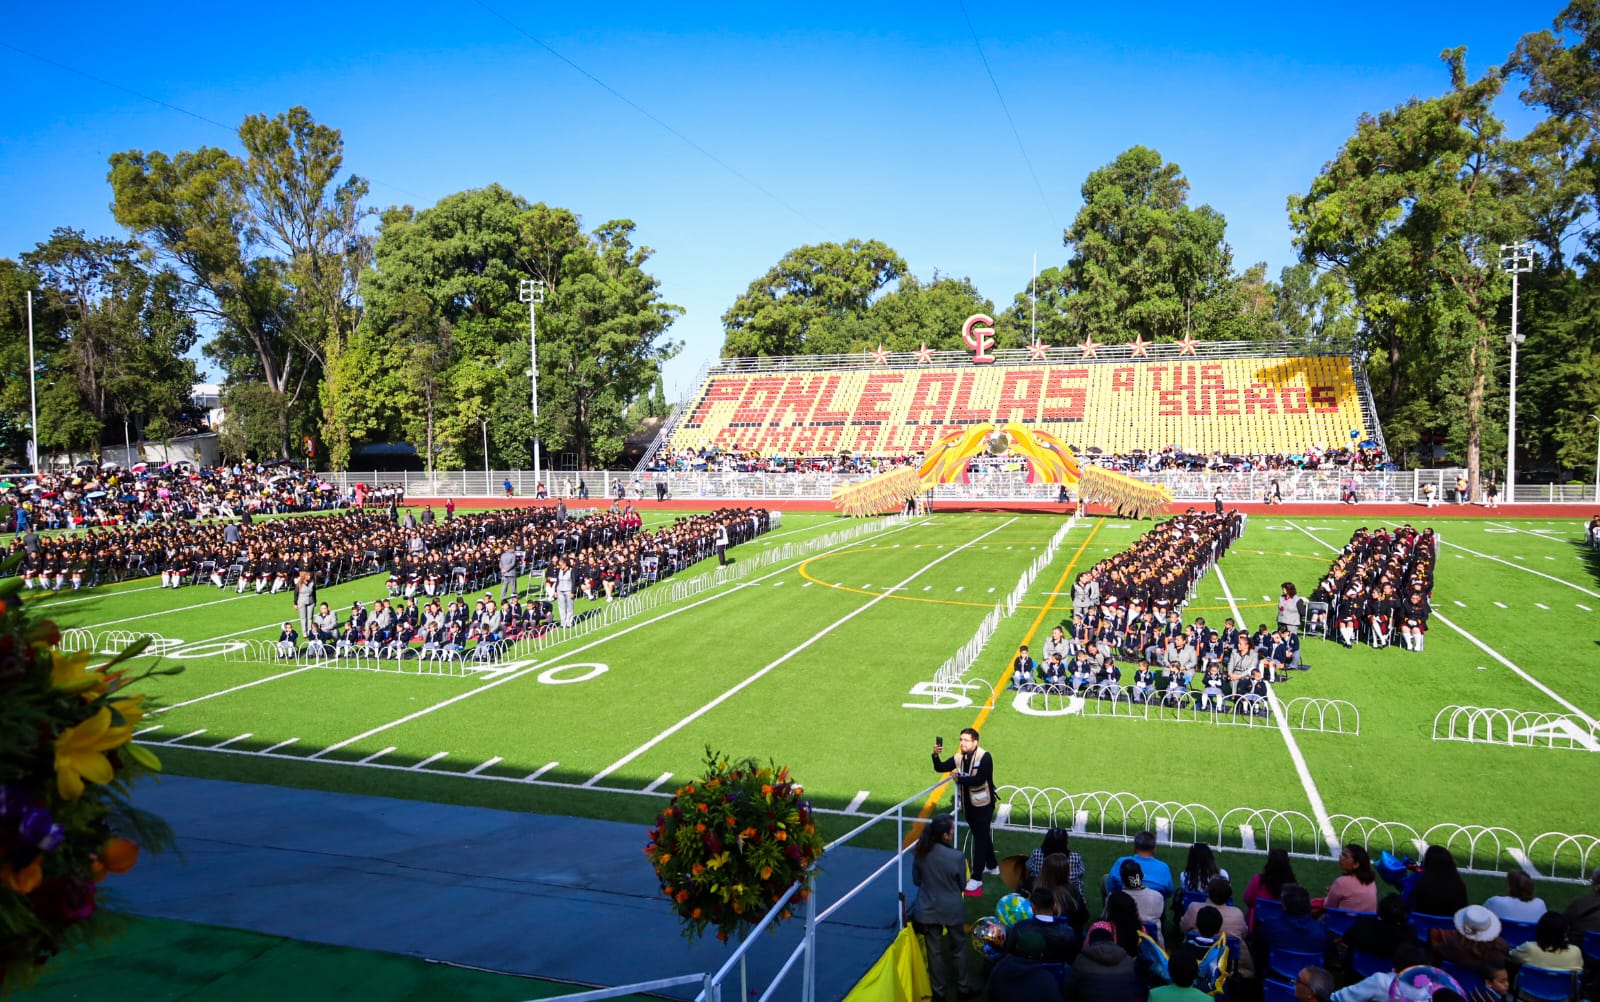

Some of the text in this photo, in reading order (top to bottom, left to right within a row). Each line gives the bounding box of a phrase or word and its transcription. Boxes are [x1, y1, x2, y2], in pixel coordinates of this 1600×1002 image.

[1112, 364, 1224, 392] A TUS
[684, 369, 1089, 428] PONLE ALAS
[1159, 383, 1339, 416] SUEÑOS
[902, 681, 1085, 716] 50
